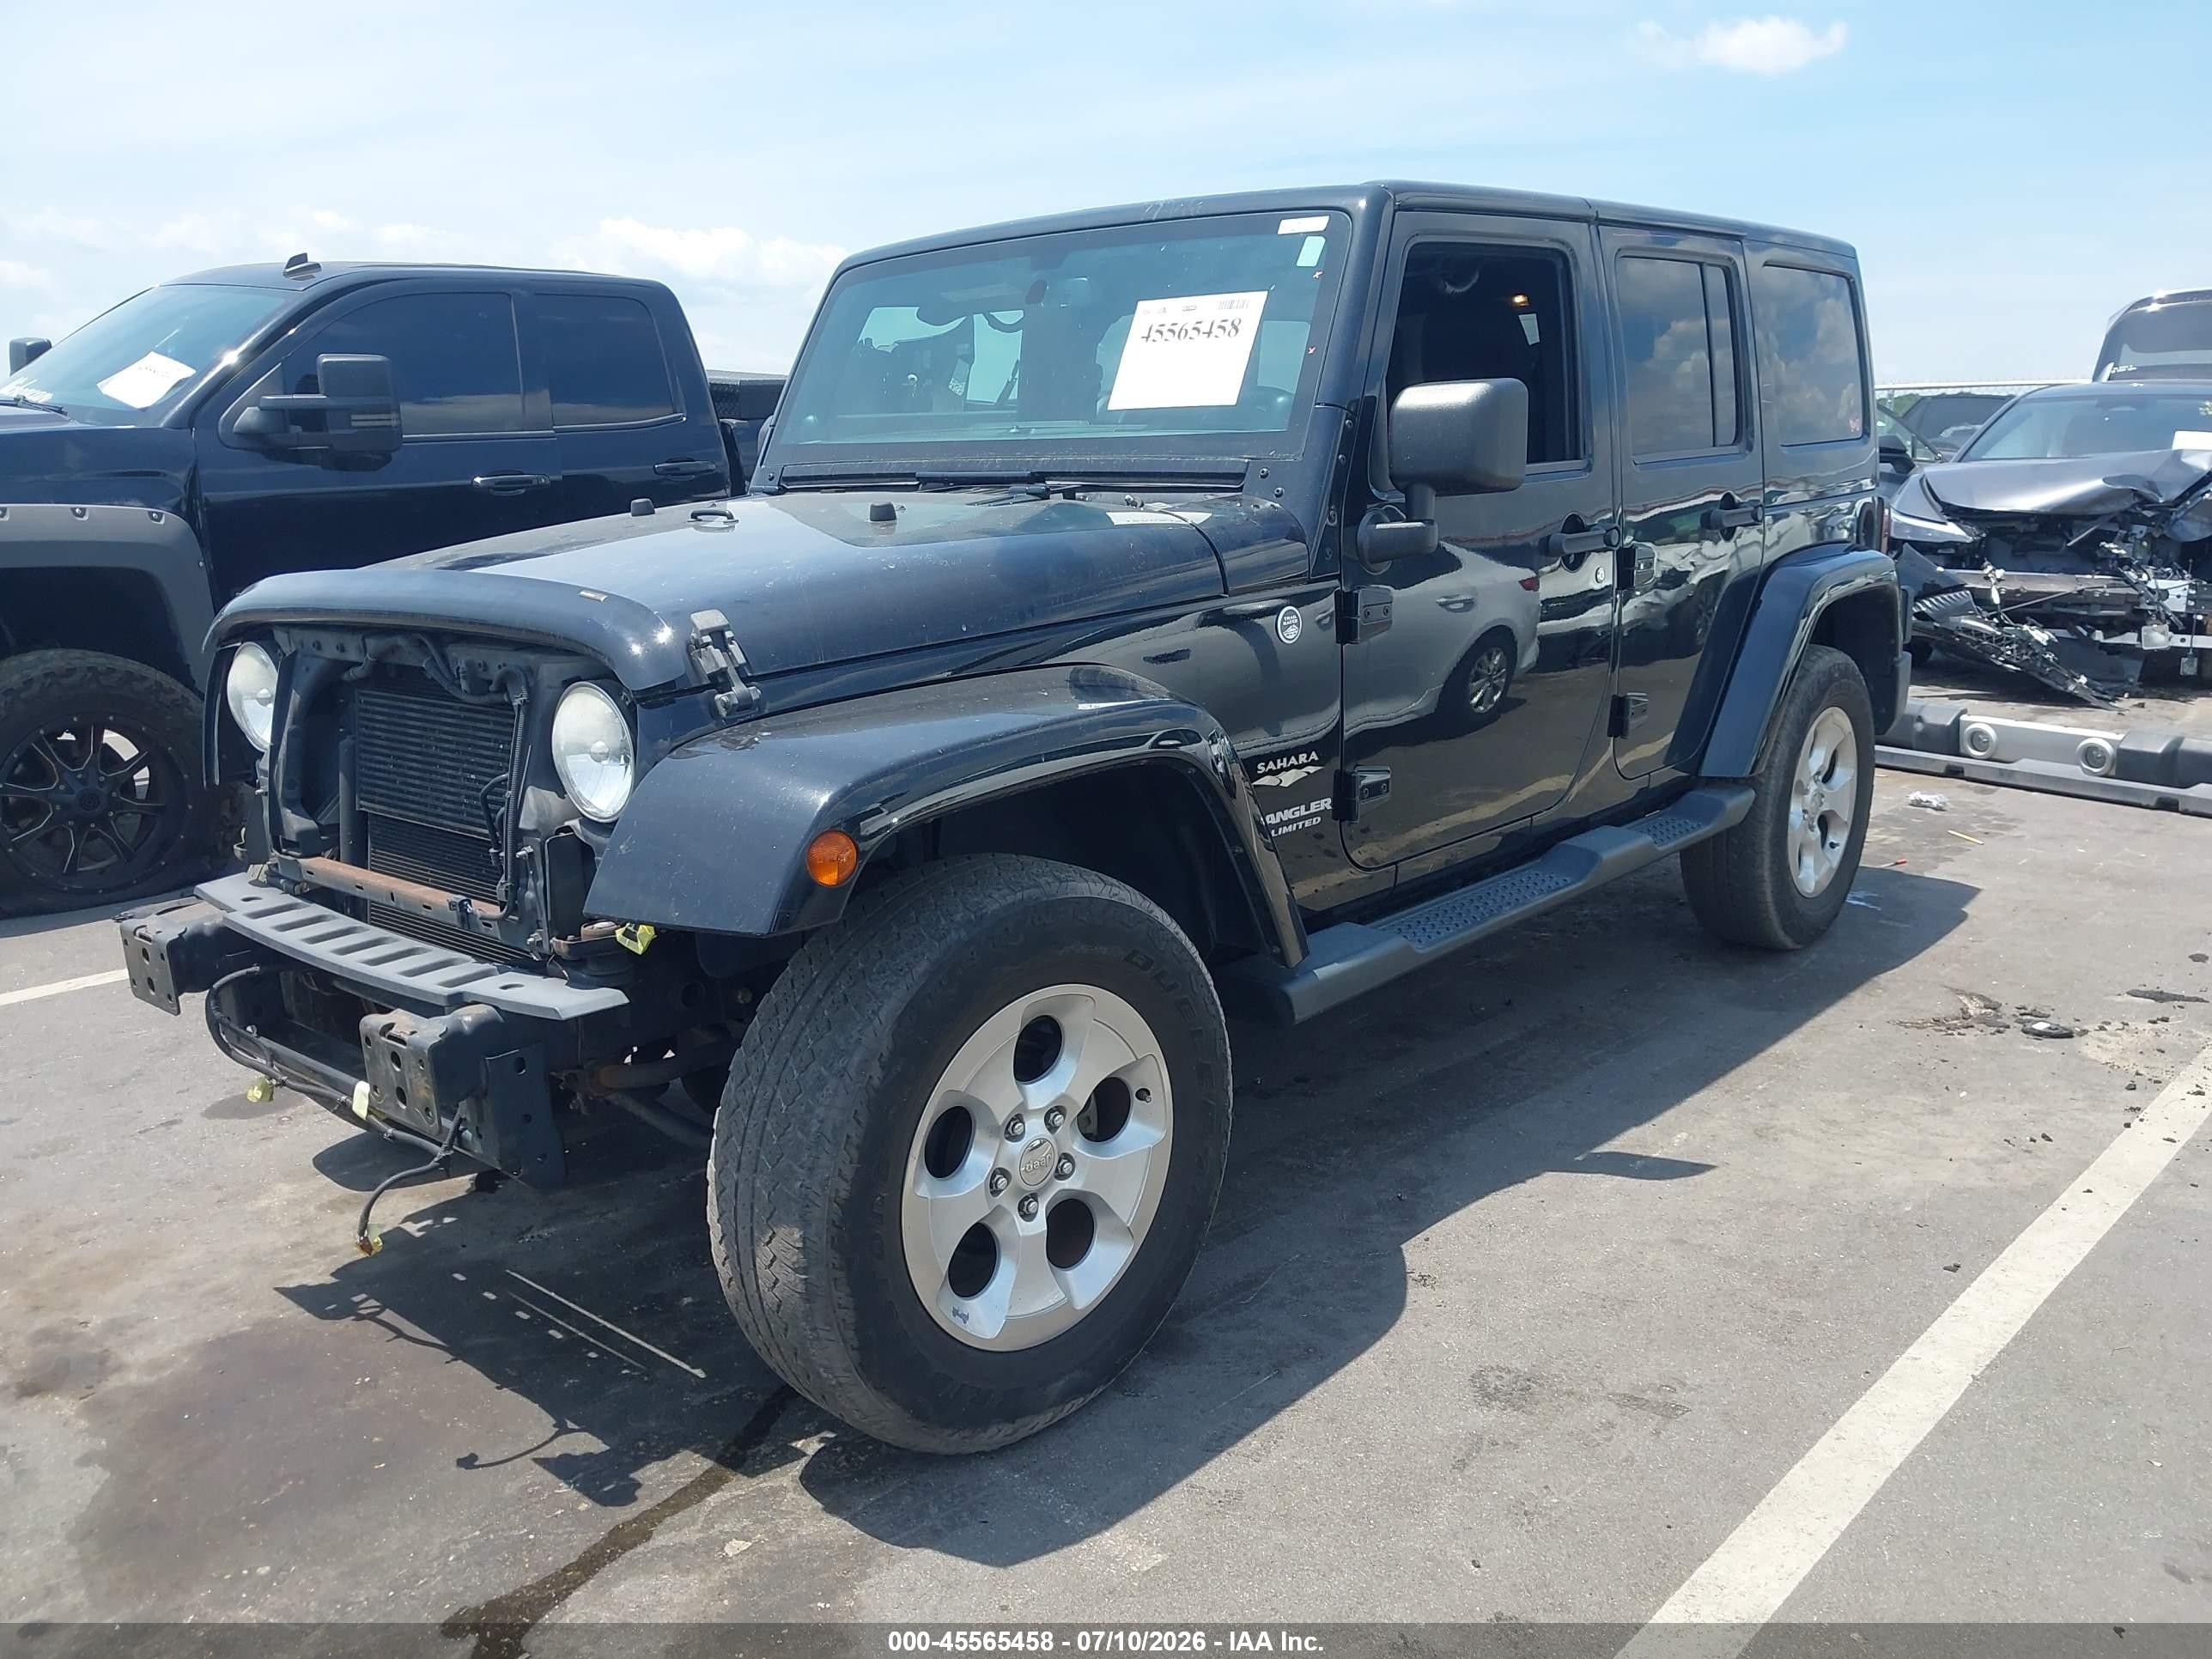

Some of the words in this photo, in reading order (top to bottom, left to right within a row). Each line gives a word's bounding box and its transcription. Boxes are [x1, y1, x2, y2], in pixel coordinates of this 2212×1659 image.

[1140, 318, 1242, 343] 45565458
[1257, 750, 1319, 774] SAHARA
[1265, 798, 1333, 825] ANGLER
[1271, 817, 1322, 837] LIMITED
[1025, 1153, 1052, 1173] Jeep
